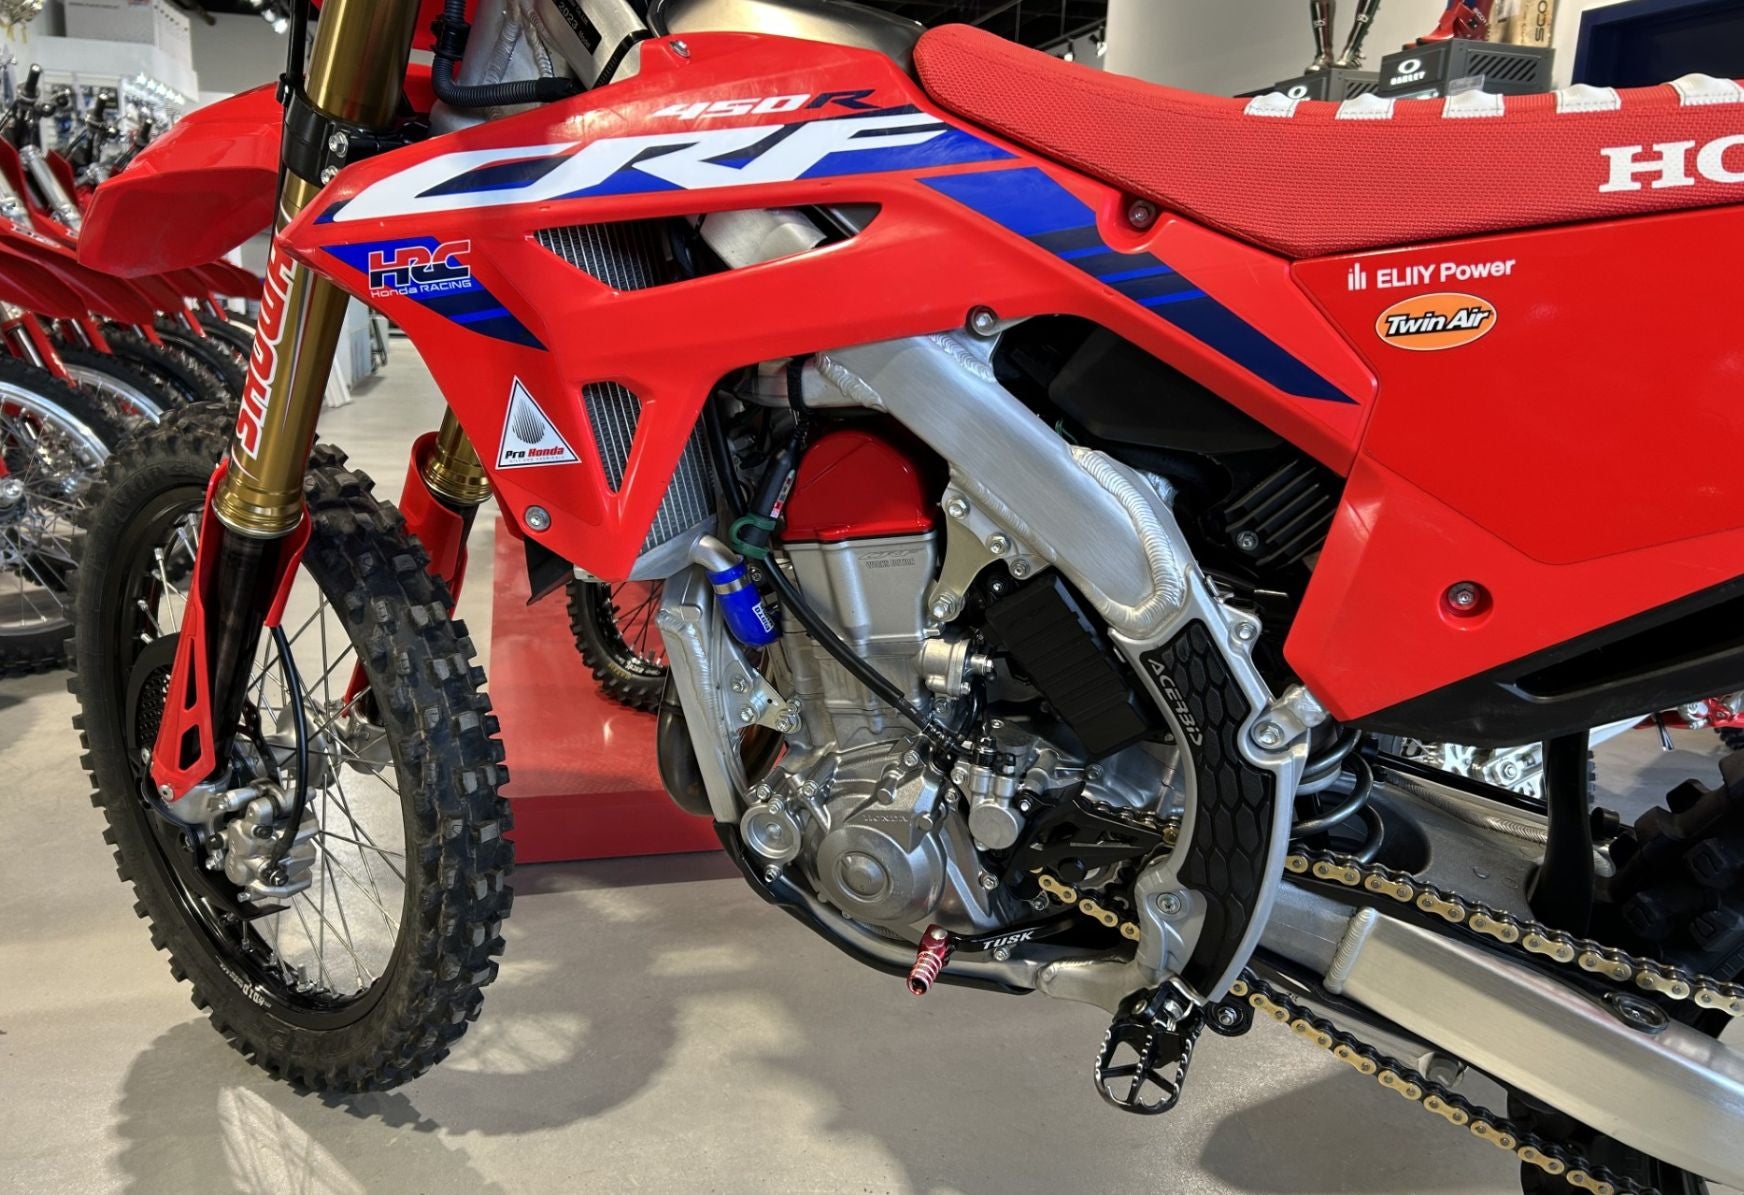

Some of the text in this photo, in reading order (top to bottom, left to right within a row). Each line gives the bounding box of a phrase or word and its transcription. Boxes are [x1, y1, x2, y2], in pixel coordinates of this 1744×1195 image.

[650, 88, 882, 121] 450R
[333, 112, 948, 222] CRF
[368, 239, 471, 291] HRC
[1439, 259, 1516, 283] Power
[370, 279, 472, 298] Honda RACING
[1386, 307, 1493, 337] Twin Air
[504, 446, 564, 459] Pro Honda
[983, 930, 1034, 950] TUSK
